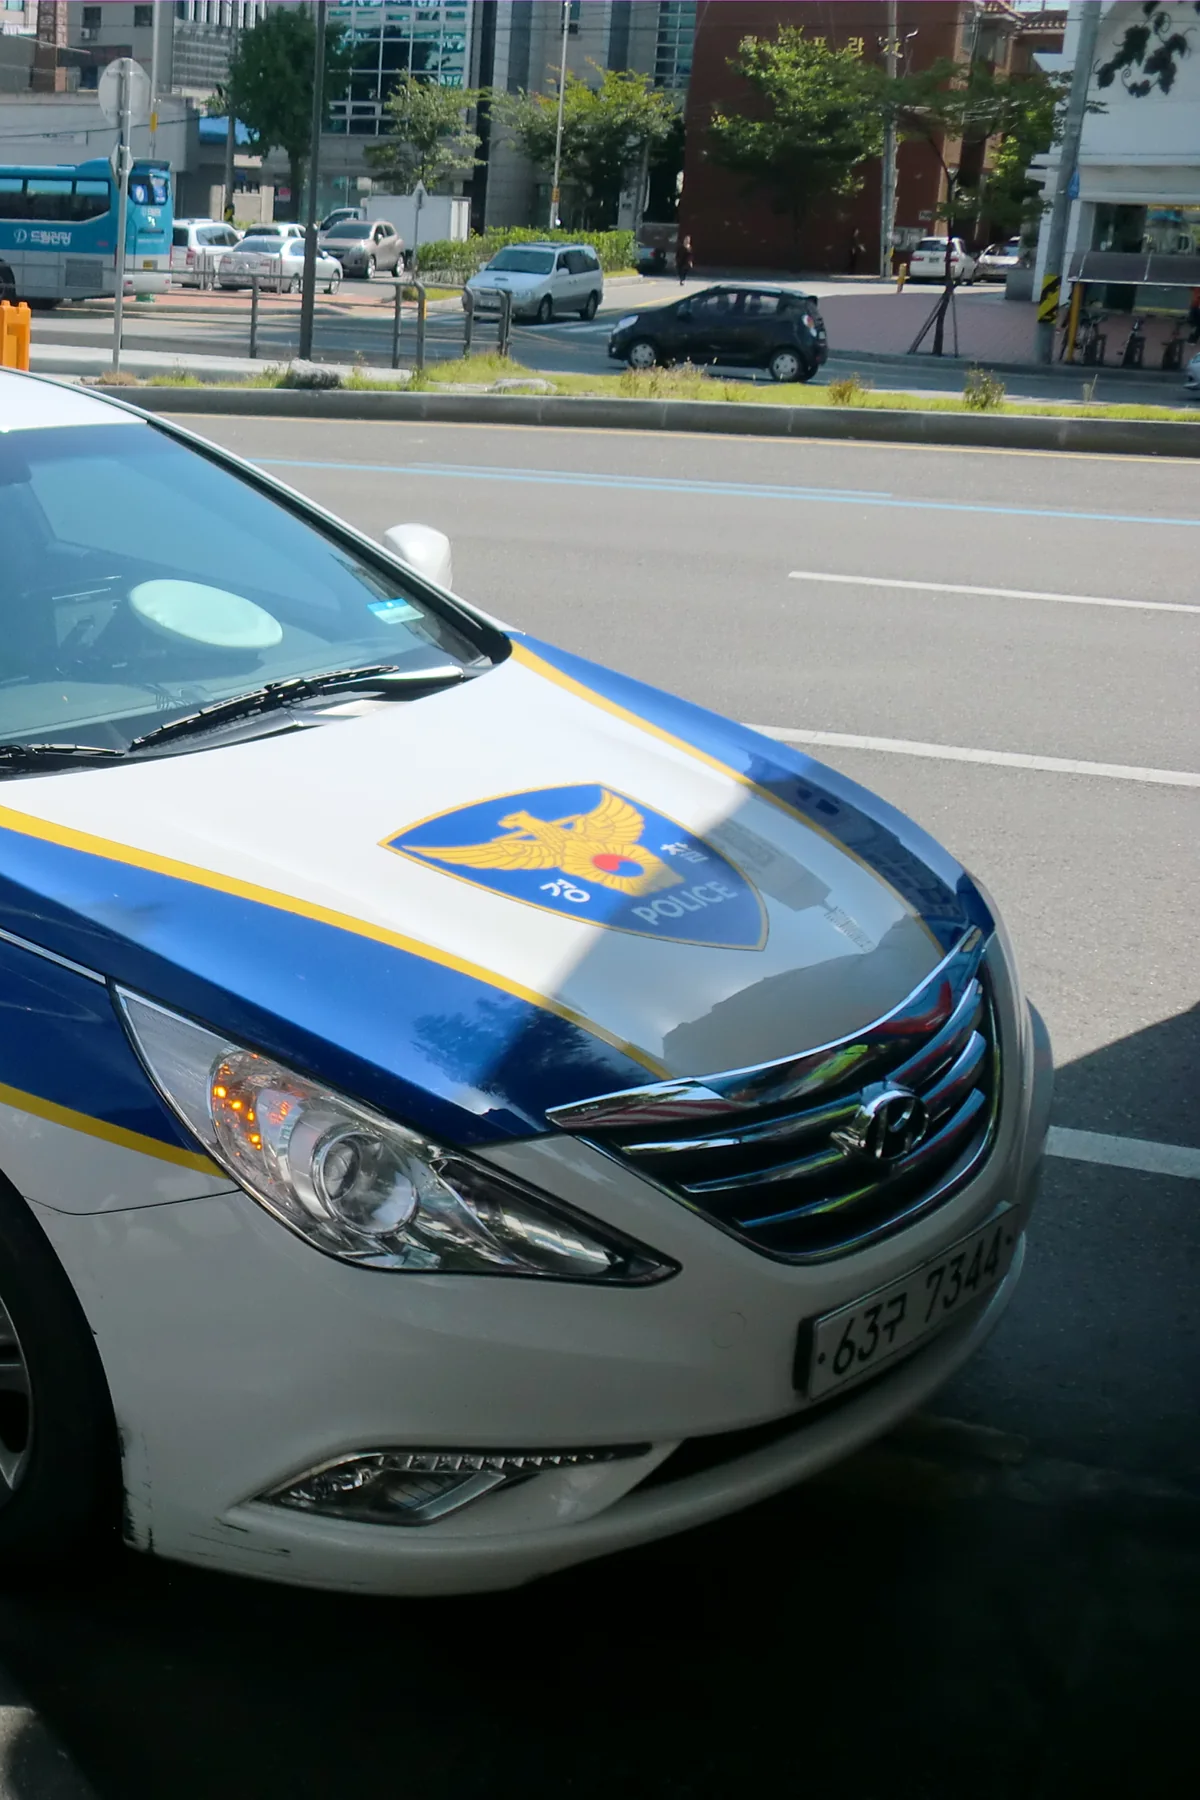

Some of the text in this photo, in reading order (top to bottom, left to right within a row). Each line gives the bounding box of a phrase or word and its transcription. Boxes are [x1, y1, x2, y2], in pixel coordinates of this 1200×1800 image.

[539, 877, 592, 904] 경
[631, 880, 738, 926] POLICE
[924, 1225, 1003, 1324] 7344
